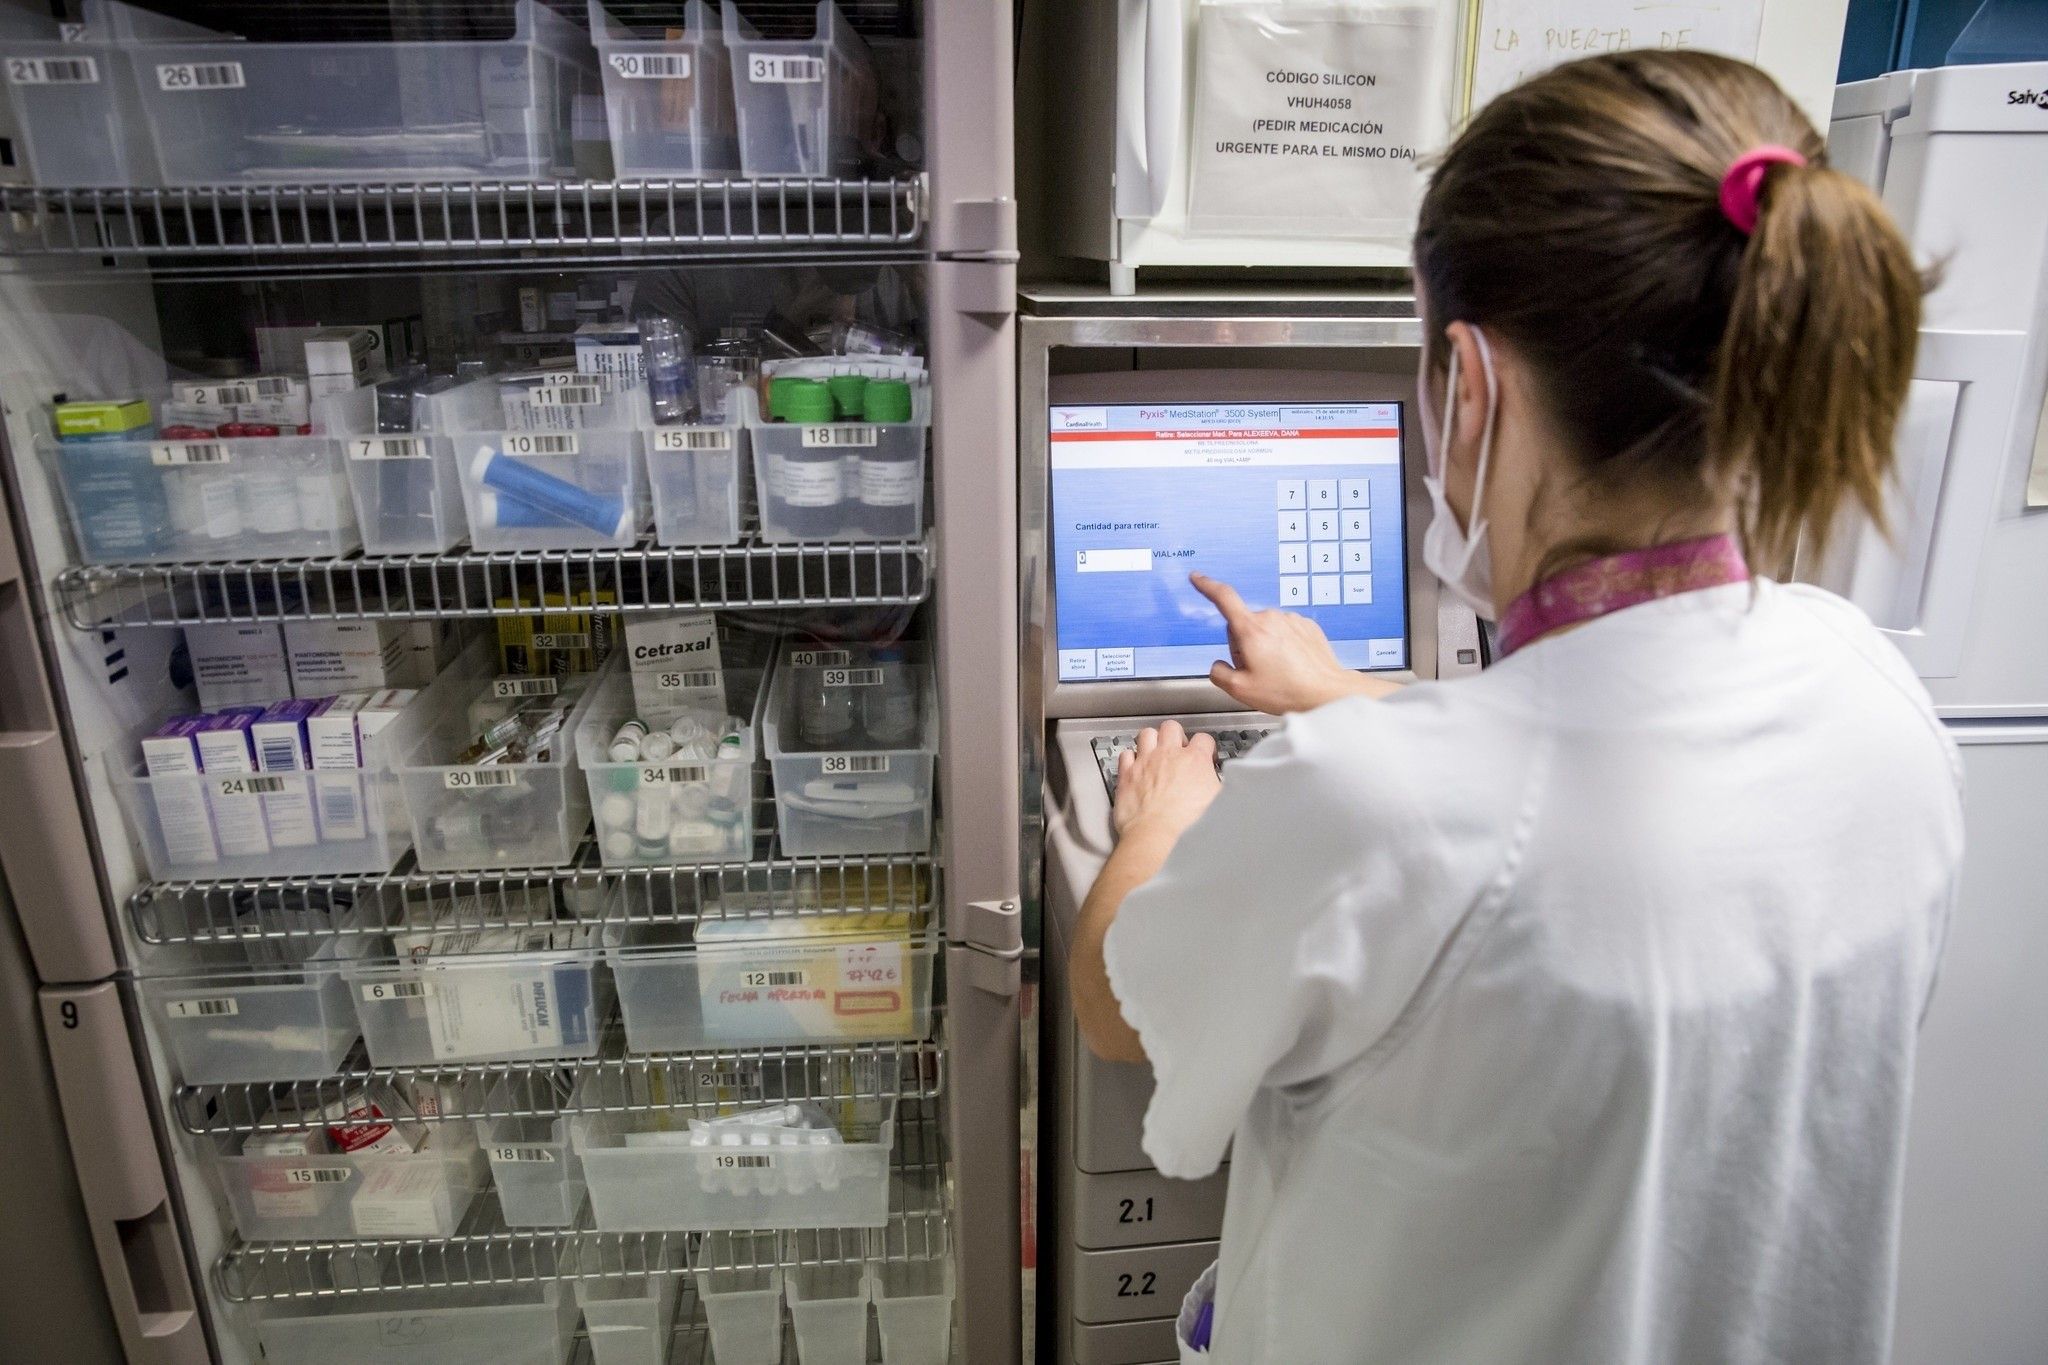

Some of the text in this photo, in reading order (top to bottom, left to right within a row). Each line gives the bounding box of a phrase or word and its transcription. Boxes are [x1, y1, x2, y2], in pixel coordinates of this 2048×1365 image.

[1494, 27, 1692, 51] LA PUERTA DE
[11, 63, 39, 80] 21
[614, 55, 638, 74] 30
[755, 60, 777, 78] 31
[163, 67, 191, 86] 26
[1265, 69, 1376, 87] CÓDIGO SILICON
[1287, 96, 1352, 110] VHUH4058
[1252, 119, 1383, 135] (PEDIR MEDICACIÓN
[1215, 141, 1416, 161] URGENTE PARA EL MISMO DÍA)
[194, 389, 206, 404] 2
[536, 388, 553, 403] 11
[1224, 409, 1246, 418] 3500
[1247, 409, 1279, 419] System
[660, 431, 683, 448] 15
[808, 428, 830, 443] 18
[360, 441, 371, 456] 7
[509, 437, 531, 453] 10
[163, 446, 173, 461] 1
[1288, 489, 1359, 500] 7 8 9
[1075, 521, 1160, 532] Cantidad para retirar:
[1290, 521, 1360, 532] 4 5 6
[1152, 549, 1196, 559] VIAL+AMP
[1291, 553, 1361, 563] 1 2 3
[1291, 587, 1298, 596] 0
[535, 635, 553, 648] 32
[635, 636, 712, 660] Cetraxal
[795, 652, 813, 665] 40
[1375, 649, 1397, 657] Cancelar
[660, 674, 681, 688] 35
[826, 671, 845, 684] 39
[499, 682, 517, 695] 31
[825, 757, 846, 771] 38
[449, 772, 471, 786] 30
[644, 769, 665, 783] 34
[222, 781, 244, 795] 24
[746, 973, 765, 986] 12
[373, 985, 384, 998] 6
[61, 1001, 79, 1029] 9
[178, 1002, 186, 1015] 1
[496, 1148, 514, 1161] 18
[715, 1156, 734, 1168] 19
[293, 1170, 312, 1182] 15
[1119, 1197, 1154, 1223] 2.1
[1118, 1271, 1157, 1296] 2.2
